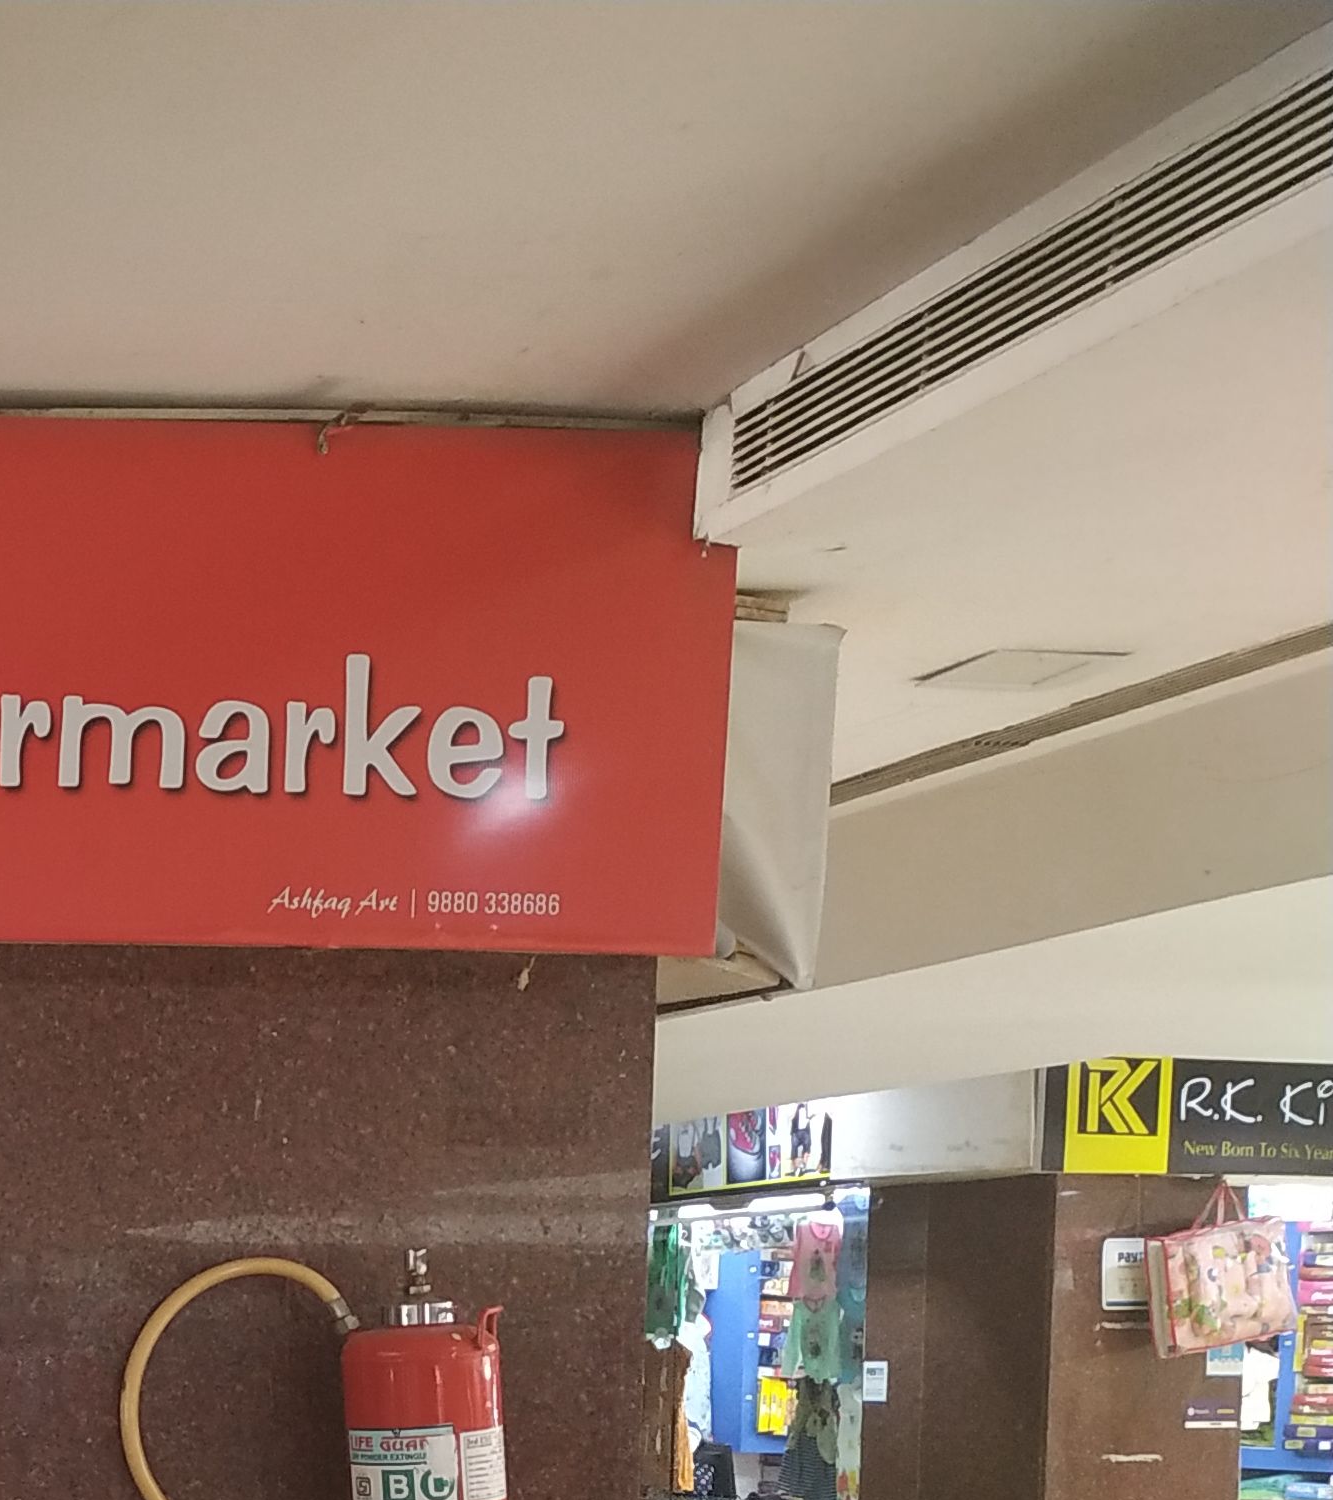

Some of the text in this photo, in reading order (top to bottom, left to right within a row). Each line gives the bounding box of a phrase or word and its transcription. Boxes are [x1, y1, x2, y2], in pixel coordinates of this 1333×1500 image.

[268, 887, 559, 918] Ashfaq Art 9880 338686
[1180, 1077, 1263, 1124] R.K.
[1183, 1140, 1217, 1156] New
[1221, 1141, 1254, 1158] Born
[1259, 1142, 1277, 1157] To
[1281, 1143, 1300, 1158] Six
